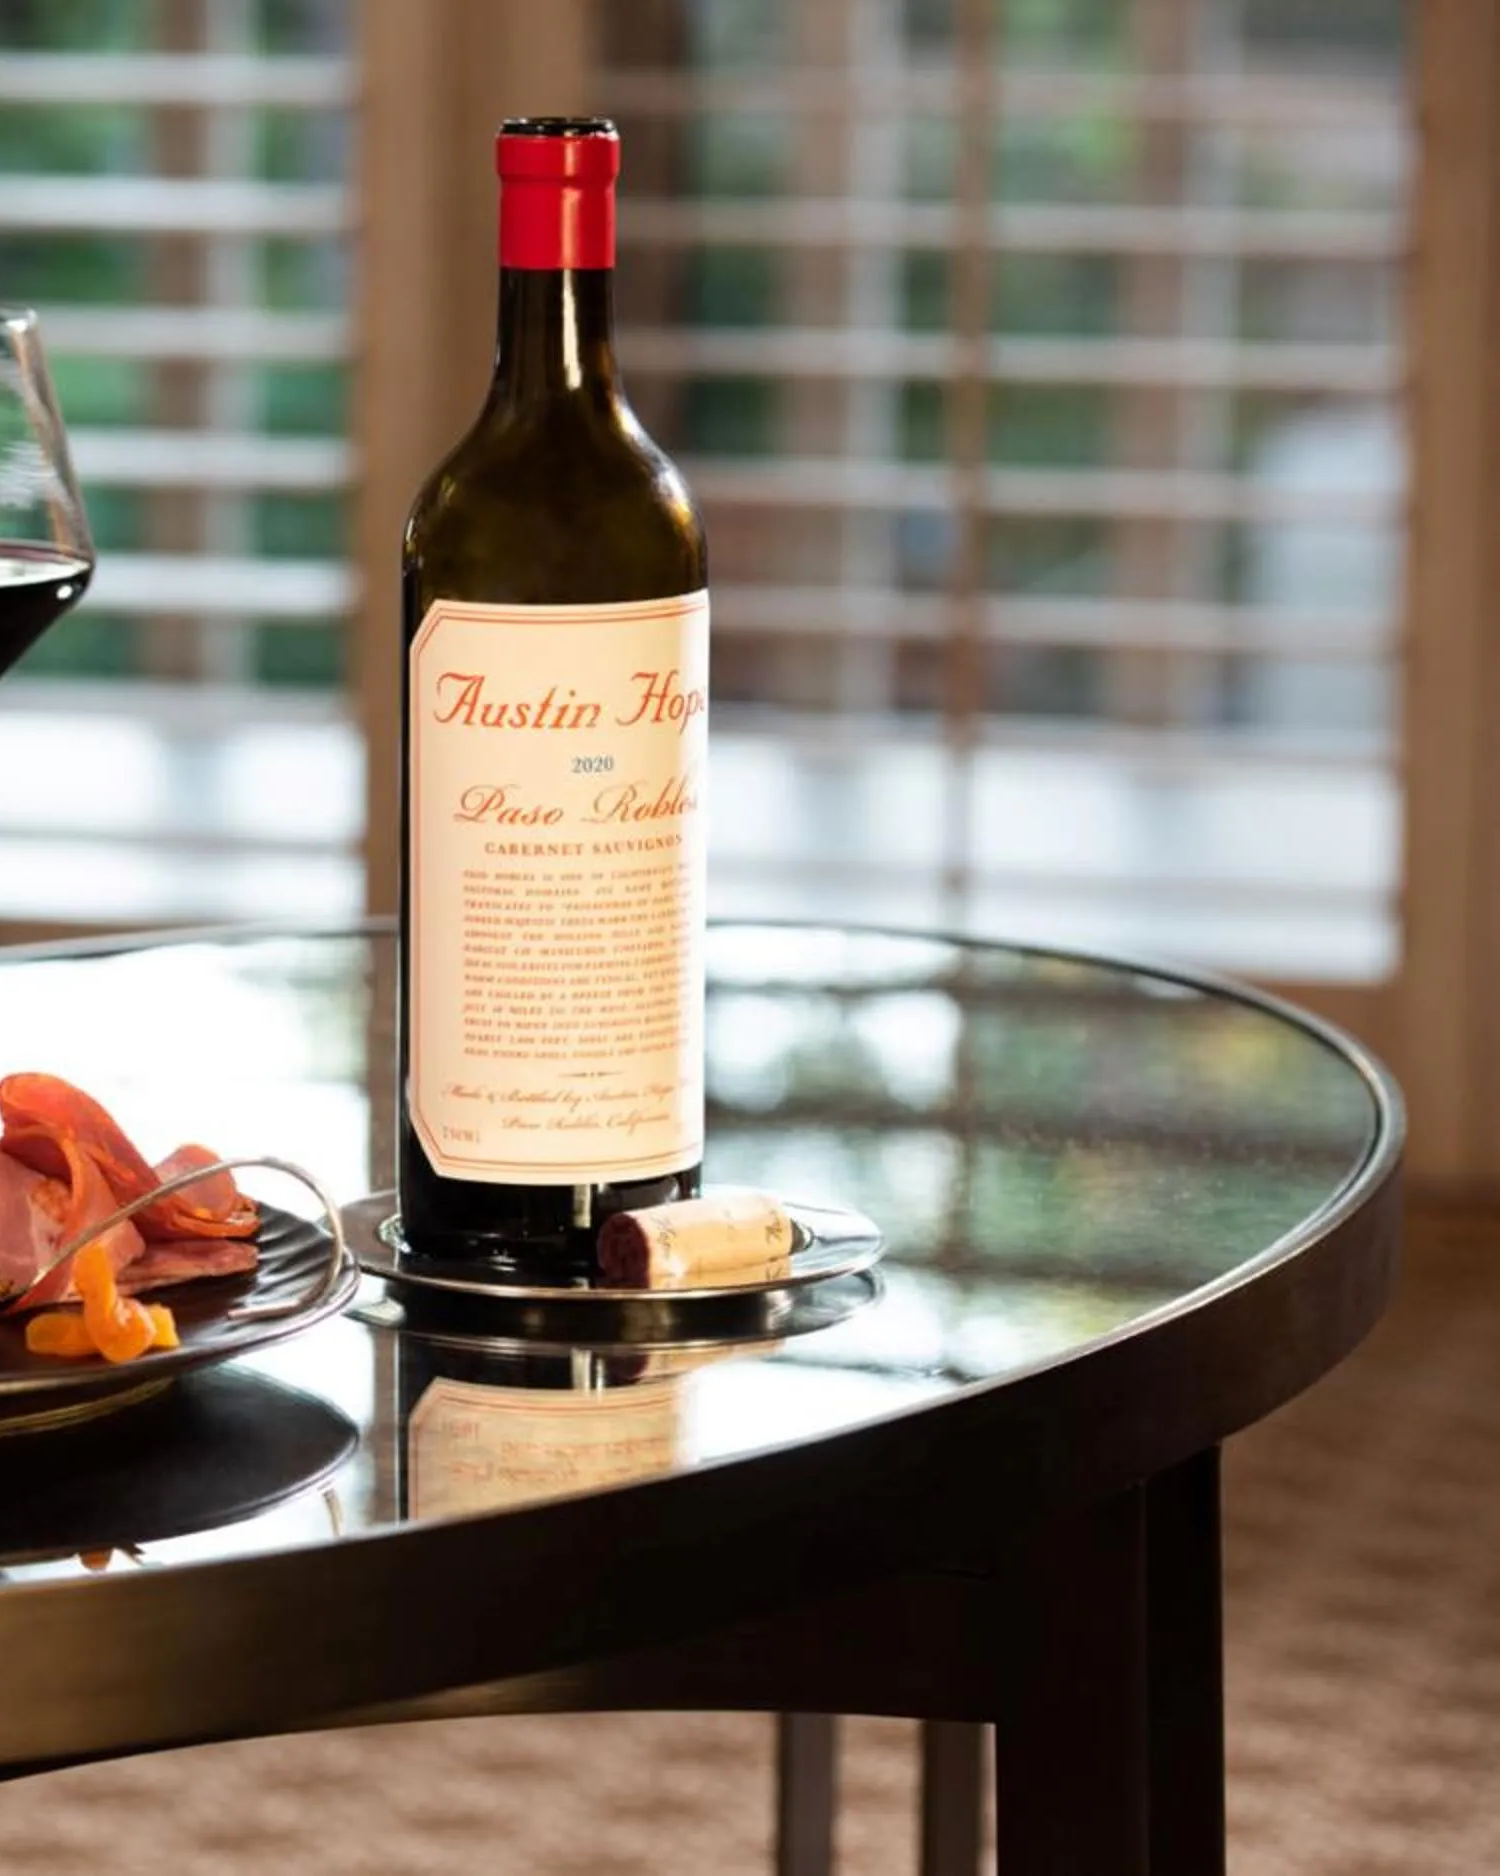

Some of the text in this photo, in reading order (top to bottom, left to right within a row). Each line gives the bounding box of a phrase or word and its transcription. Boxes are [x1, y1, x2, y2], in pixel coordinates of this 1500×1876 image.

[433, 671, 602, 729] Austin
[572, 755, 614, 774] 2020
[453, 783, 565, 826] Paso
[484, 841, 584, 857] CABERNET
